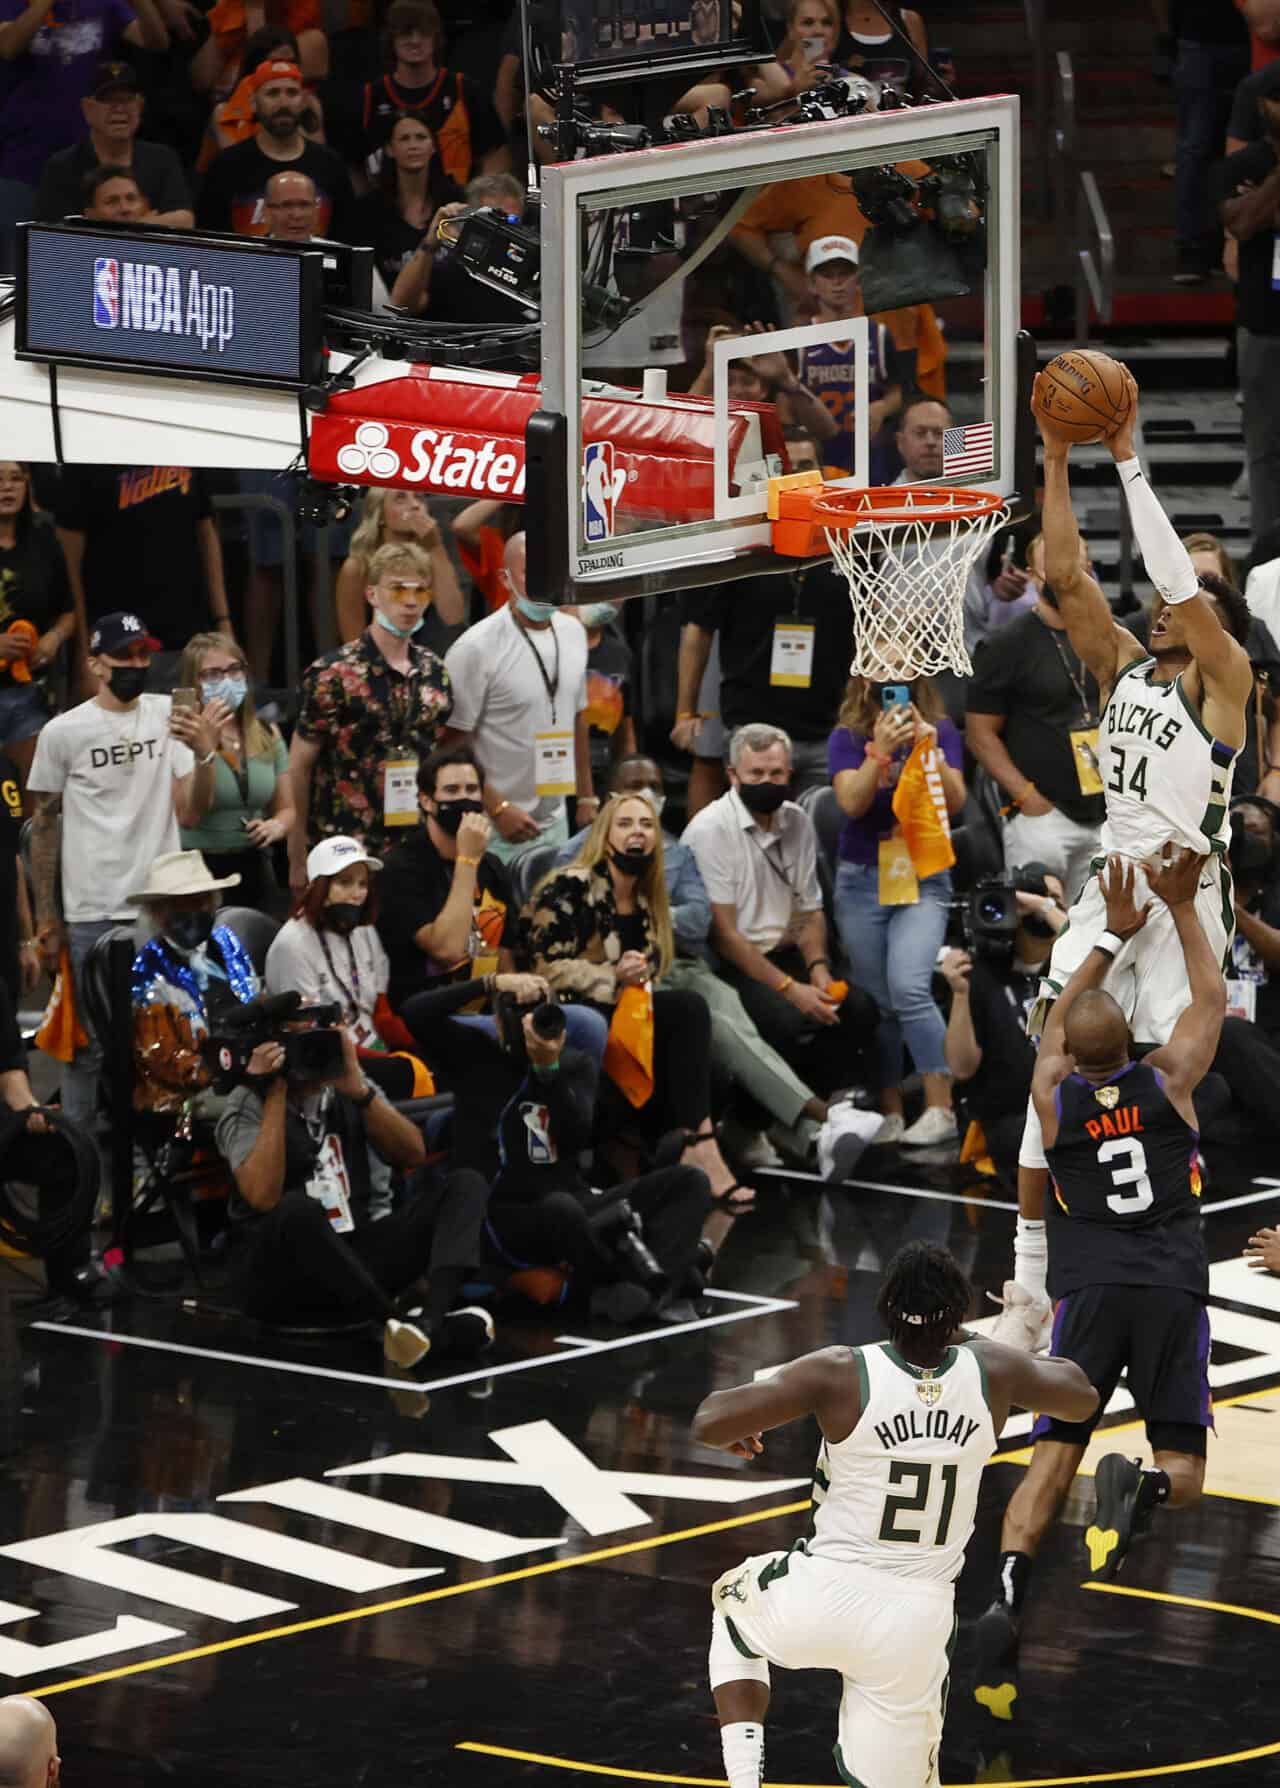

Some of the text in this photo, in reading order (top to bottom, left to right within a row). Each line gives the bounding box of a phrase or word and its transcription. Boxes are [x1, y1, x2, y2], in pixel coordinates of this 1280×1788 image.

[122, 262, 234, 352] NBA App
[402, 430, 517, 493] State
[577, 552, 624, 575] SPALDING
[90, 740, 163, 769] DEPT.
[1108, 746, 1148, 802] 34
[1084, 1104, 1145, 1141] PAUL
[1097, 1136, 1154, 1215] 3
[874, 1410, 980, 1450] HOLIDAY
[878, 1460, 958, 1546] 21
